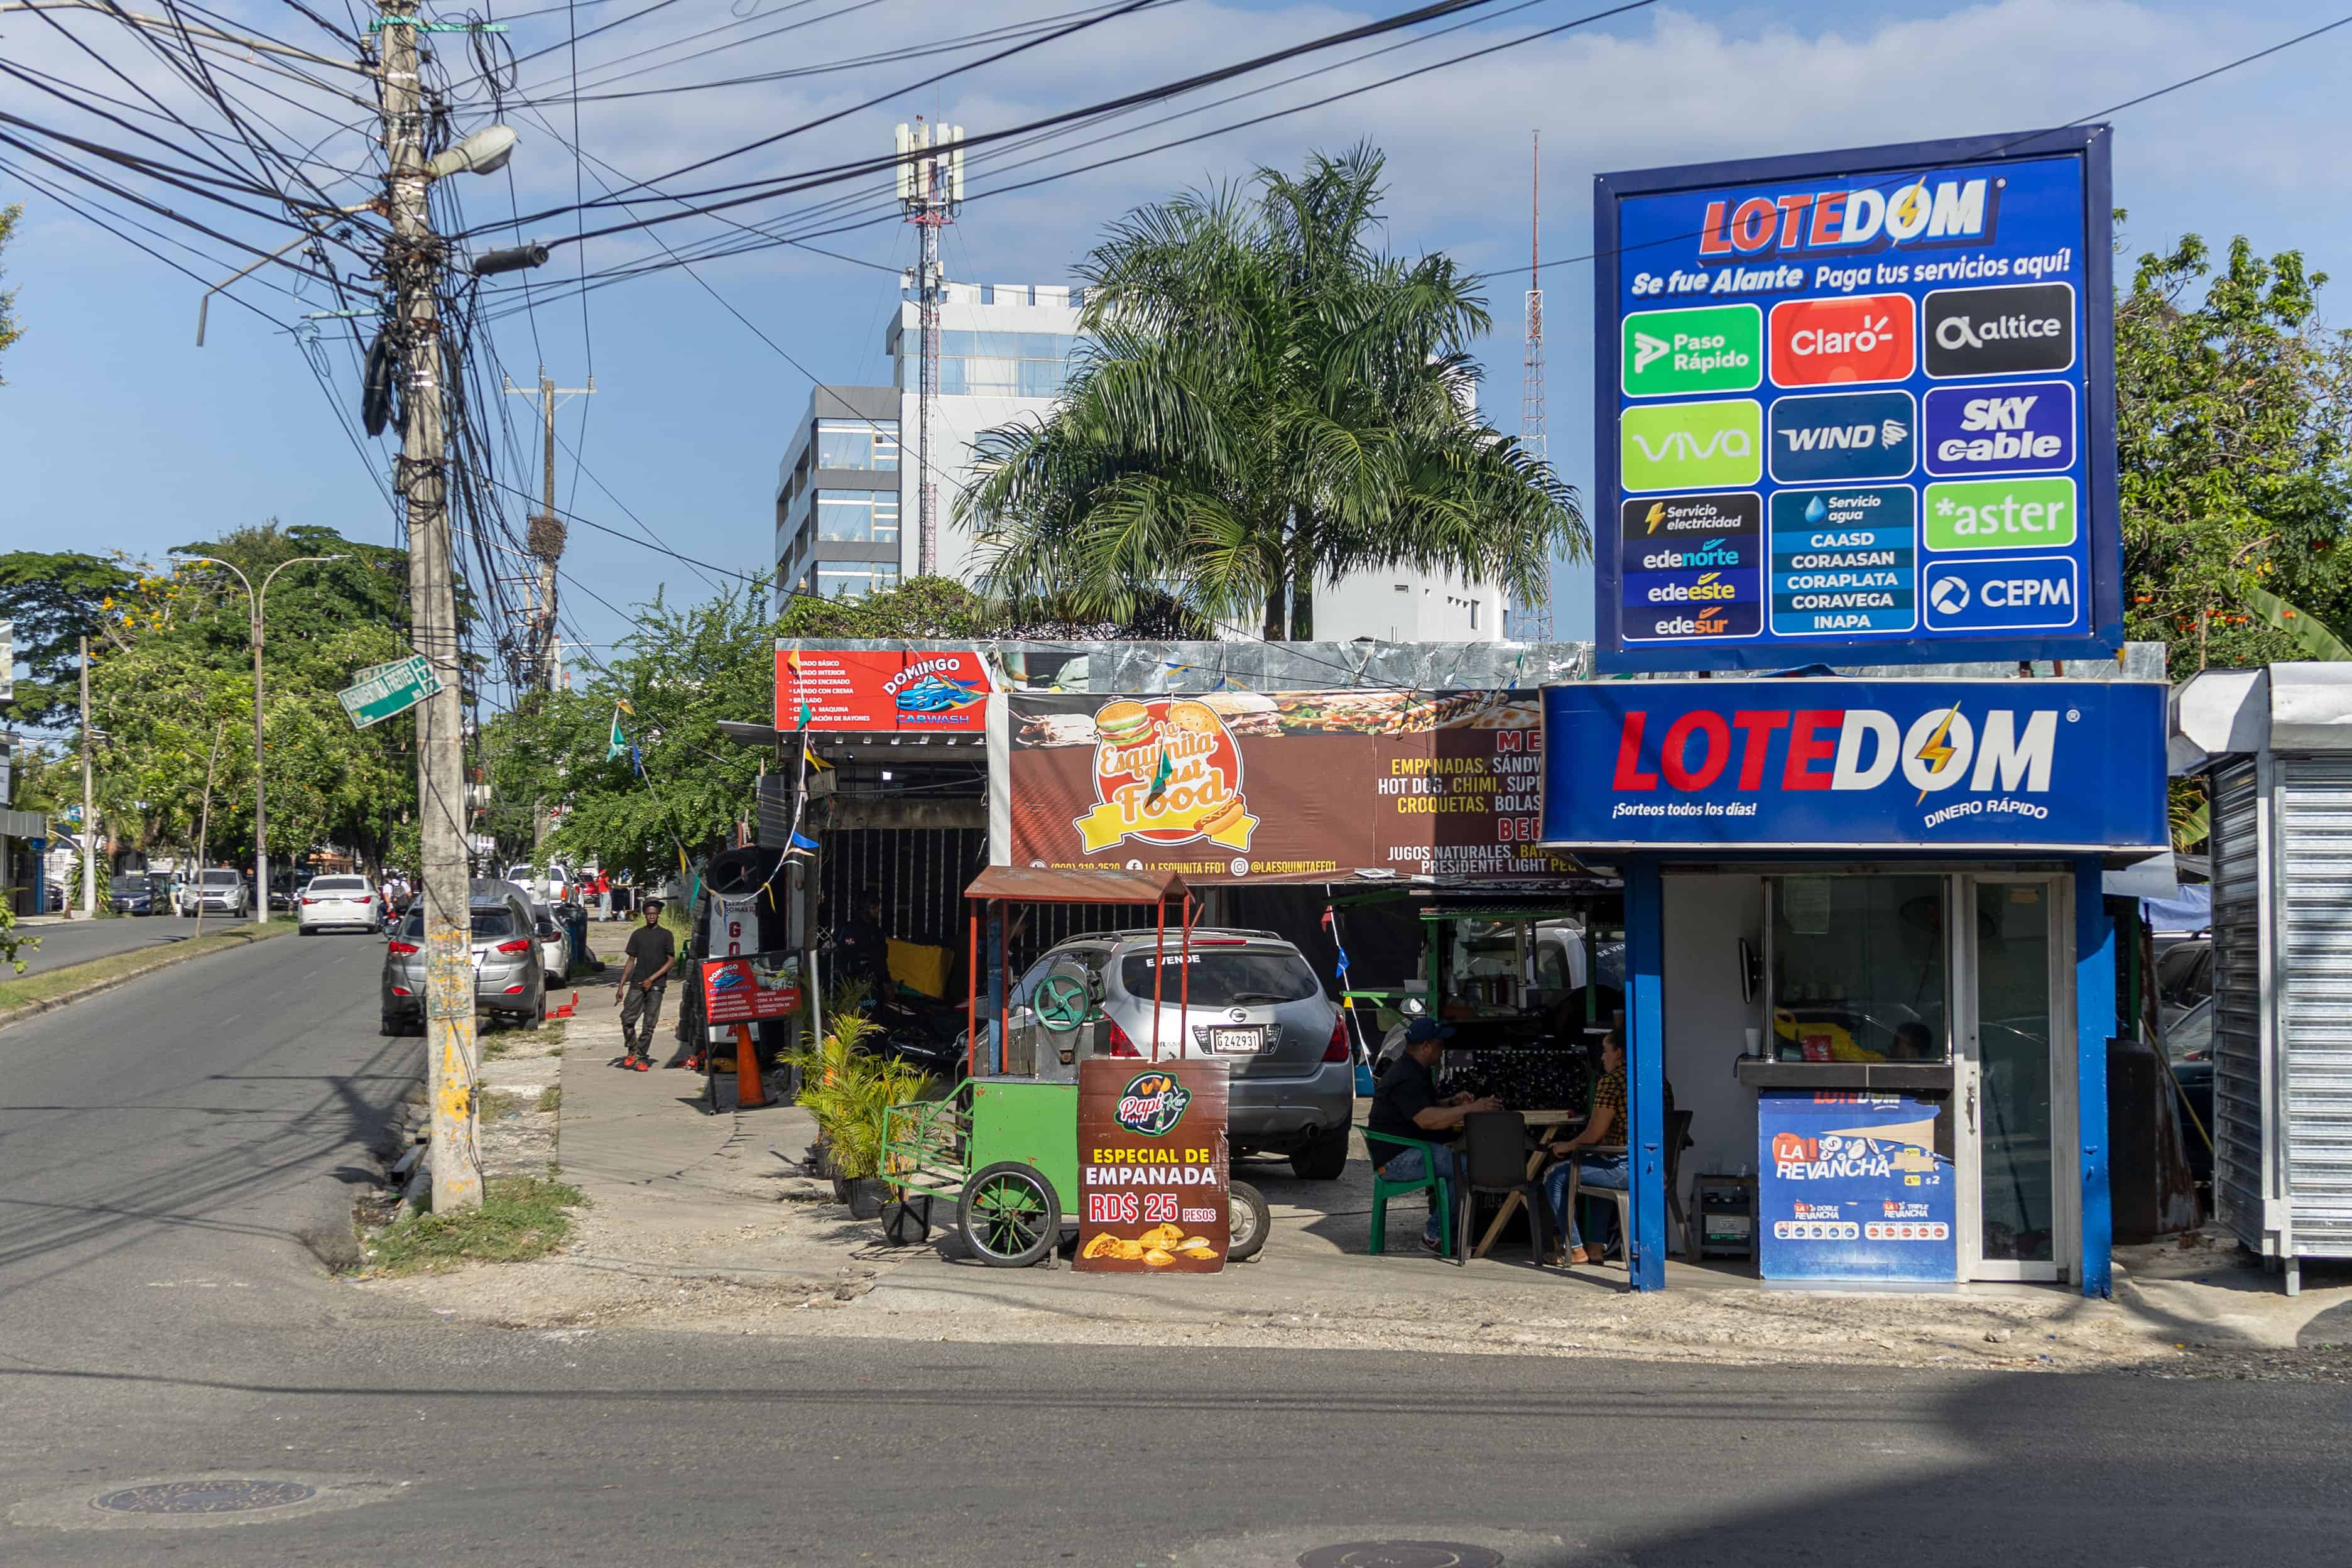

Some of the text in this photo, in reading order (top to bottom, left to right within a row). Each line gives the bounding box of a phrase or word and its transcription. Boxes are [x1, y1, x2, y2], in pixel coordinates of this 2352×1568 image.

[1699, 178, 1987, 255] LOTEDOM
[1631, 248, 2071, 295] Se fue Alante Paga tus servicios aquí!
[1979, 314, 2062, 340] altice
[1674, 334, 1726, 351] Paso
[1791, 327, 1880, 356] Claro
[1674, 350, 1750, 374] Rápido
[1960, 396, 2039, 431] SKY
[1777, 425, 1876, 452] WIND
[1937, 431, 2062, 462] cable
[1828, 494, 1881, 509] Servicio
[1667, 504, 1718, 518] Servicio
[1828, 510, 1863, 523] agua
[1667, 515, 1742, 530] electricidad
[1810, 532, 1875, 548] CAASD
[1643, 548, 1739, 569] edenorte
[1791, 552, 1895, 569] CORAASAN
[1787, 572, 1898, 590] CORAPLATA
[1648, 582, 1735, 602] edeeste
[1791, 593, 1895, 609] CORAVEGA
[1980, 578, 2071, 607] CEPM
[1655, 616, 1728, 634] edesur
[1814, 614, 1871, 629] INAPA
[883, 658, 961, 696] DOMINGO
[896, 714, 969, 724] CARWASH
[1100, 732, 1217, 778] Esquinita
[1612, 709, 2059, 793] LOTEDOM
[1391, 758, 1488, 775] EMPANADAS,
[1378, 778, 1408, 795] HOT
[1453, 776, 1502, 795] CHIMI,
[1114, 770, 1231, 822] Food
[1397, 796, 1489, 814] CROQUETAS,
[1613, 802, 1757, 819] ¡Sorteos todos los días!
[1924, 797, 2049, 829] DINERO RÁPIDO
[1387, 846, 1430, 861] JUGOS
[1434, 845, 1515, 860] NATURALES,
[1421, 859, 1503, 874] PRESIDENTE
[1508, 859, 1547, 872] LIGHT
[708, 964, 739, 983] DOMINGO
[1217, 1036, 1256, 1047] G242931
[1119, 1091, 1164, 1121] Papi
[1094, 1148, 1210, 1163] ESPECIAL DE
[1780, 1144, 1804, 1160] LA
[1086, 1167, 1217, 1185] EMPANADA
[1776, 1158, 1890, 1181] REVANCHA
[1089, 1192, 1216, 1224] RD$ 25 PESOS
[1795, 1211, 1839, 1220] REVANCHA
[1883, 1209, 1929, 1218] REVANCHA
